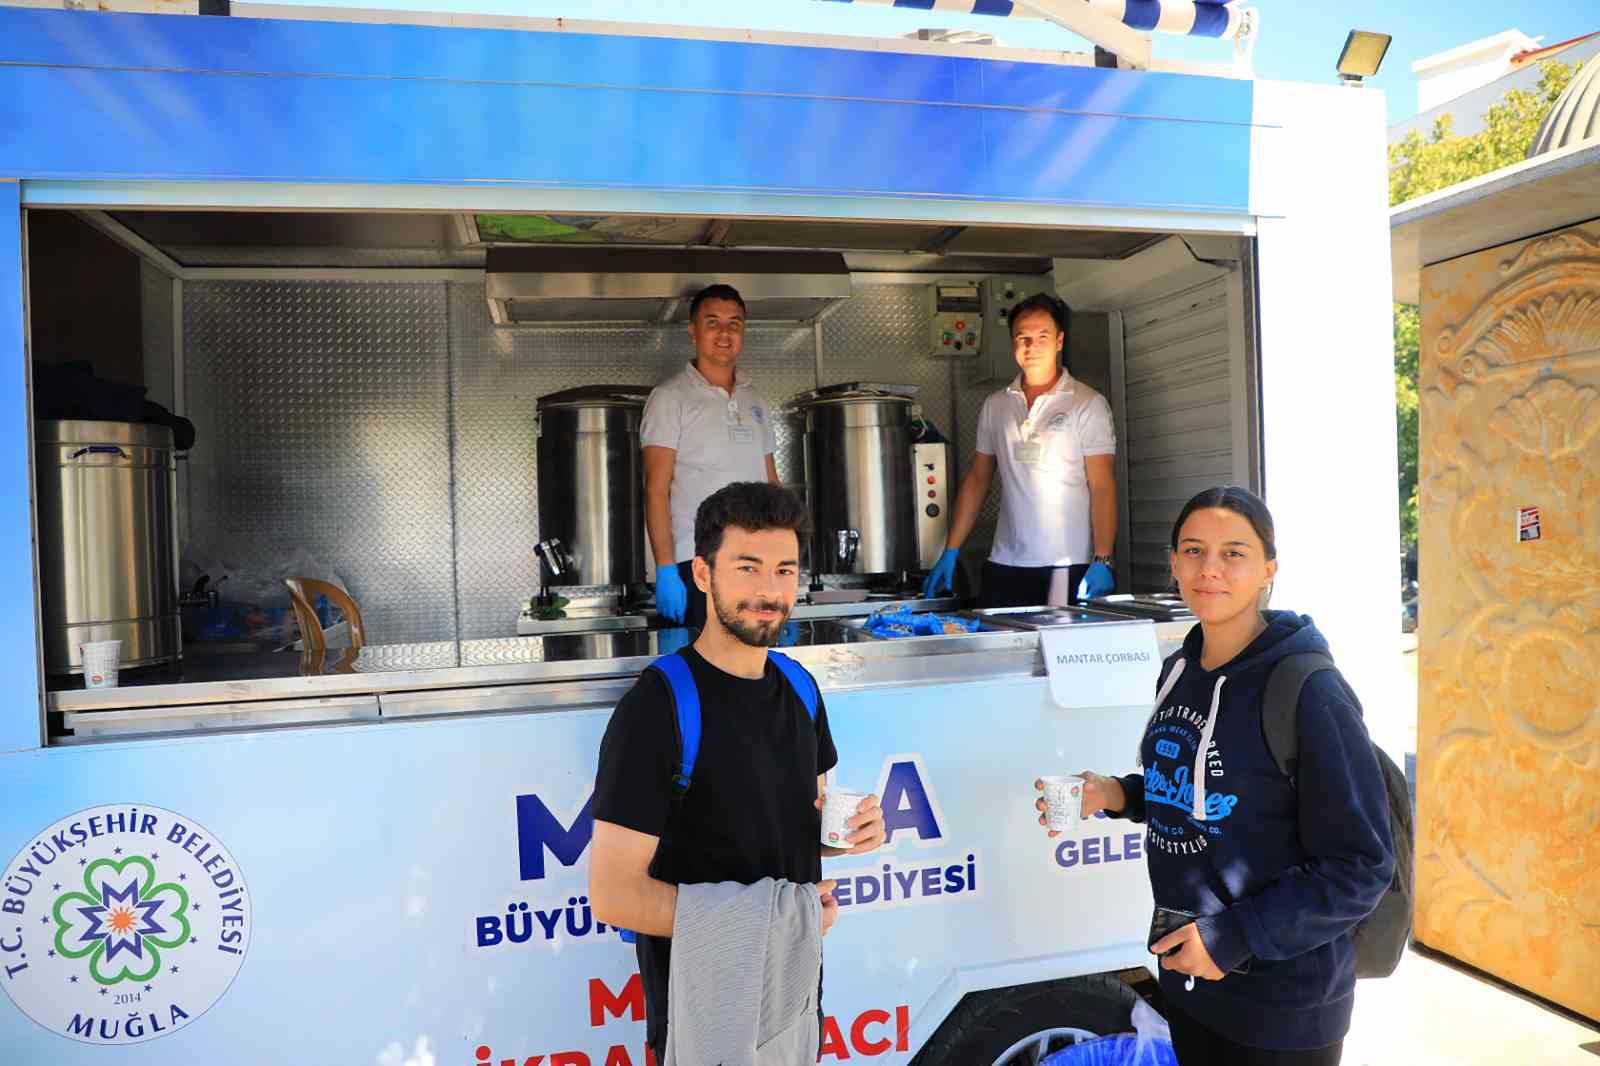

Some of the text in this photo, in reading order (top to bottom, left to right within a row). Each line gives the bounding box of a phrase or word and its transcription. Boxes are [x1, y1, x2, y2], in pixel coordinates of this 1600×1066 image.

[1056, 653, 1104, 665] MANTAR
[1055, 832, 1142, 868] GELE
[0, 807, 244, 980] T.C. BÜYÜKŞEHİR BELEDİYESİ
[475, 853, 977, 948] BÜYÜ EDİYESİ
[113, 992, 142, 1006] 2014
[66, 1003, 190, 1040] MUĞLA
[815, 1005, 910, 1064] ACI
